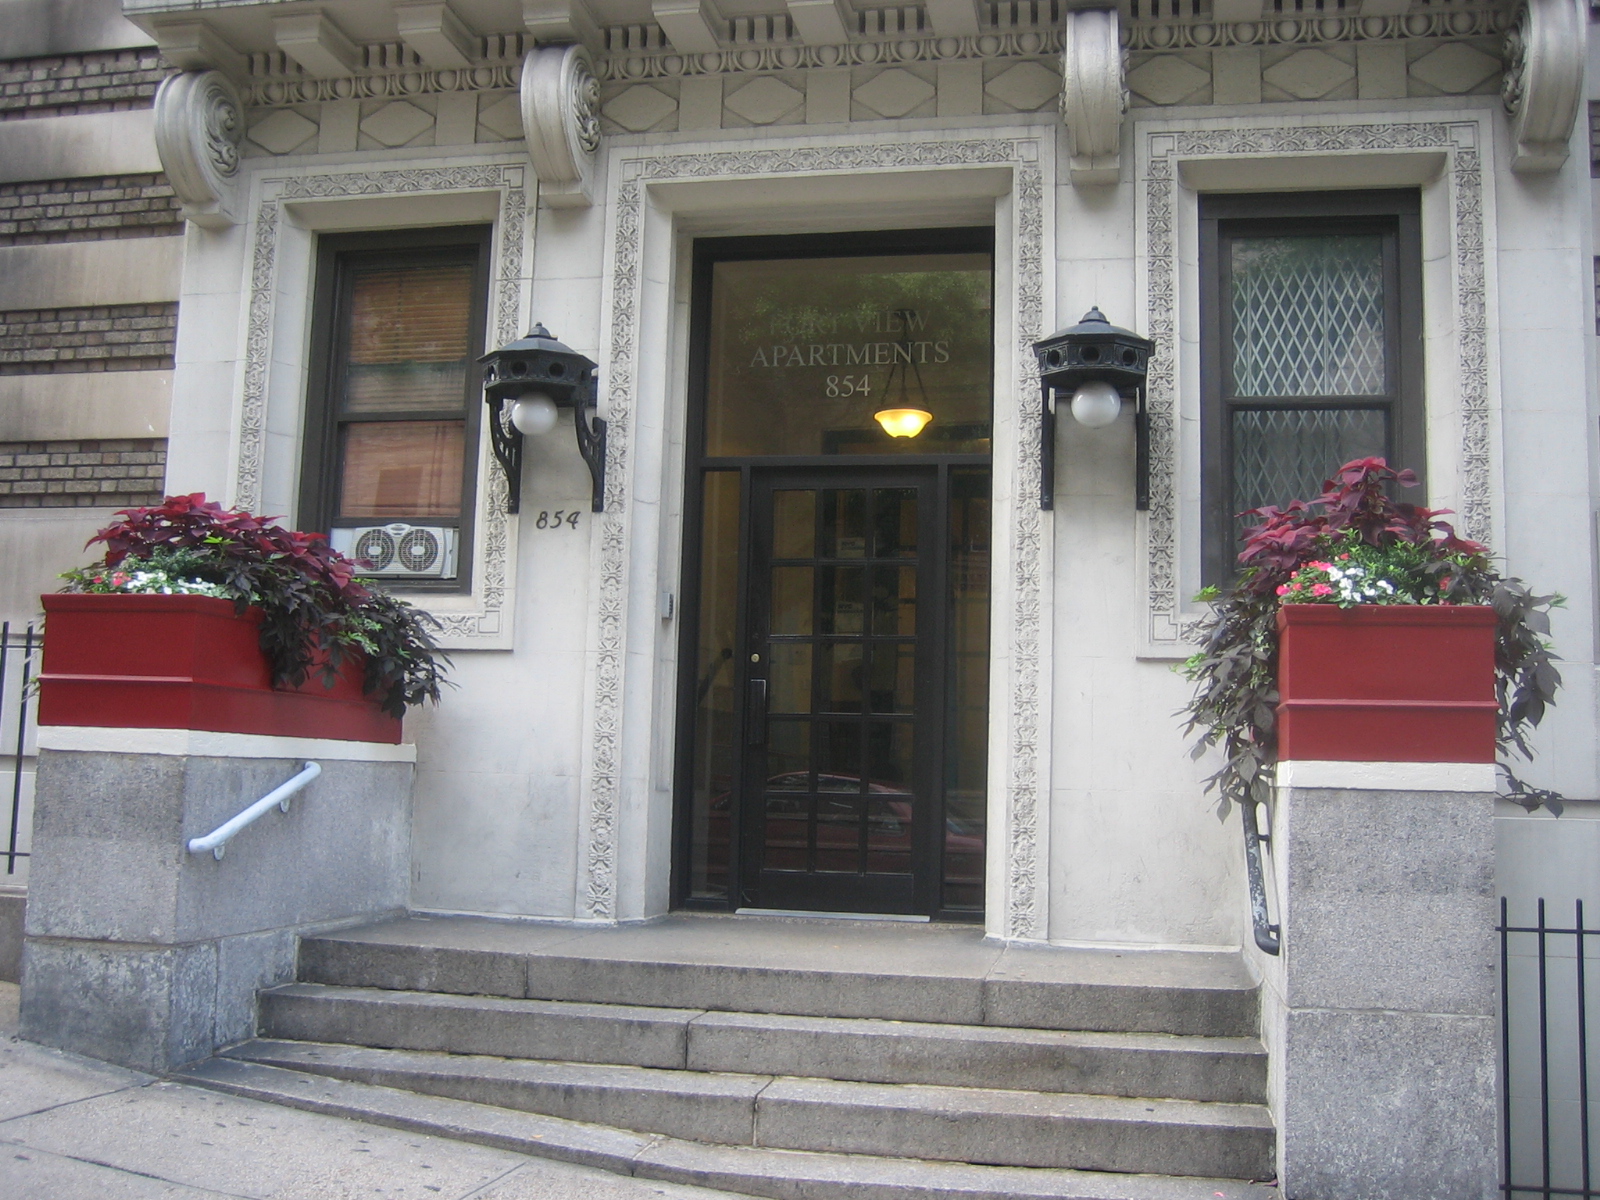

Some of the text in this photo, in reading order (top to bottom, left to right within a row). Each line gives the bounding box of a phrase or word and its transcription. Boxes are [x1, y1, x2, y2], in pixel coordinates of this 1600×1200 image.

[853, 310, 931, 333] VIEW
[749, 340, 950, 367] APARTMENTS
[825, 373, 871, 399] 854
[536, 510, 581, 529] 854
